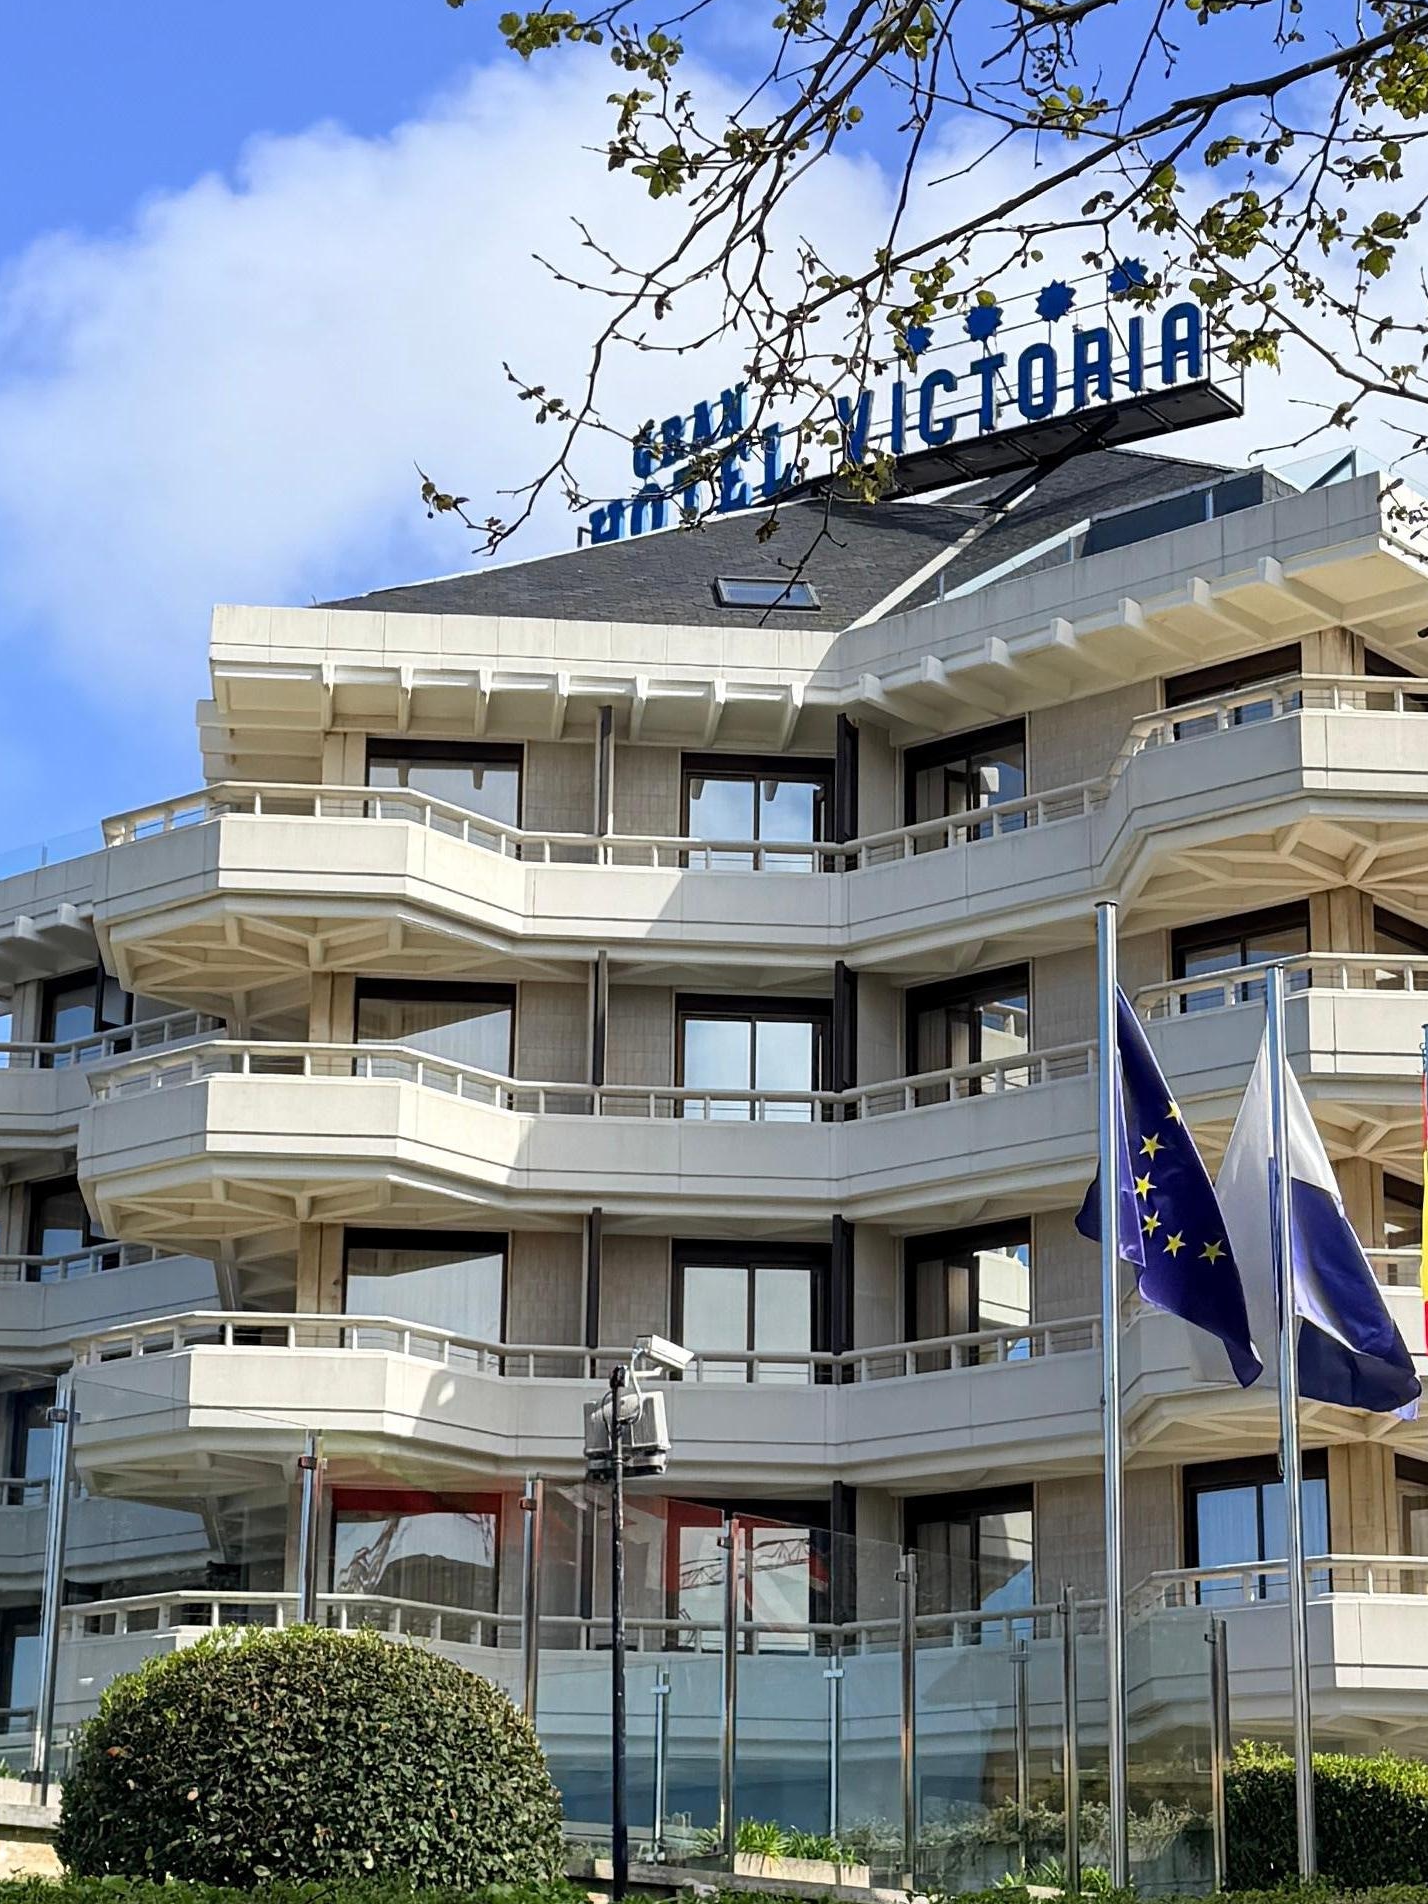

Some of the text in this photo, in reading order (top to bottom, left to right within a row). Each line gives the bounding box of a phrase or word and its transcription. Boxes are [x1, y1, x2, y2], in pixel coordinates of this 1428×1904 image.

[589, 301, 1205, 545] HOTEL VICTORIA
[633, 381, 749, 479] GRAN
